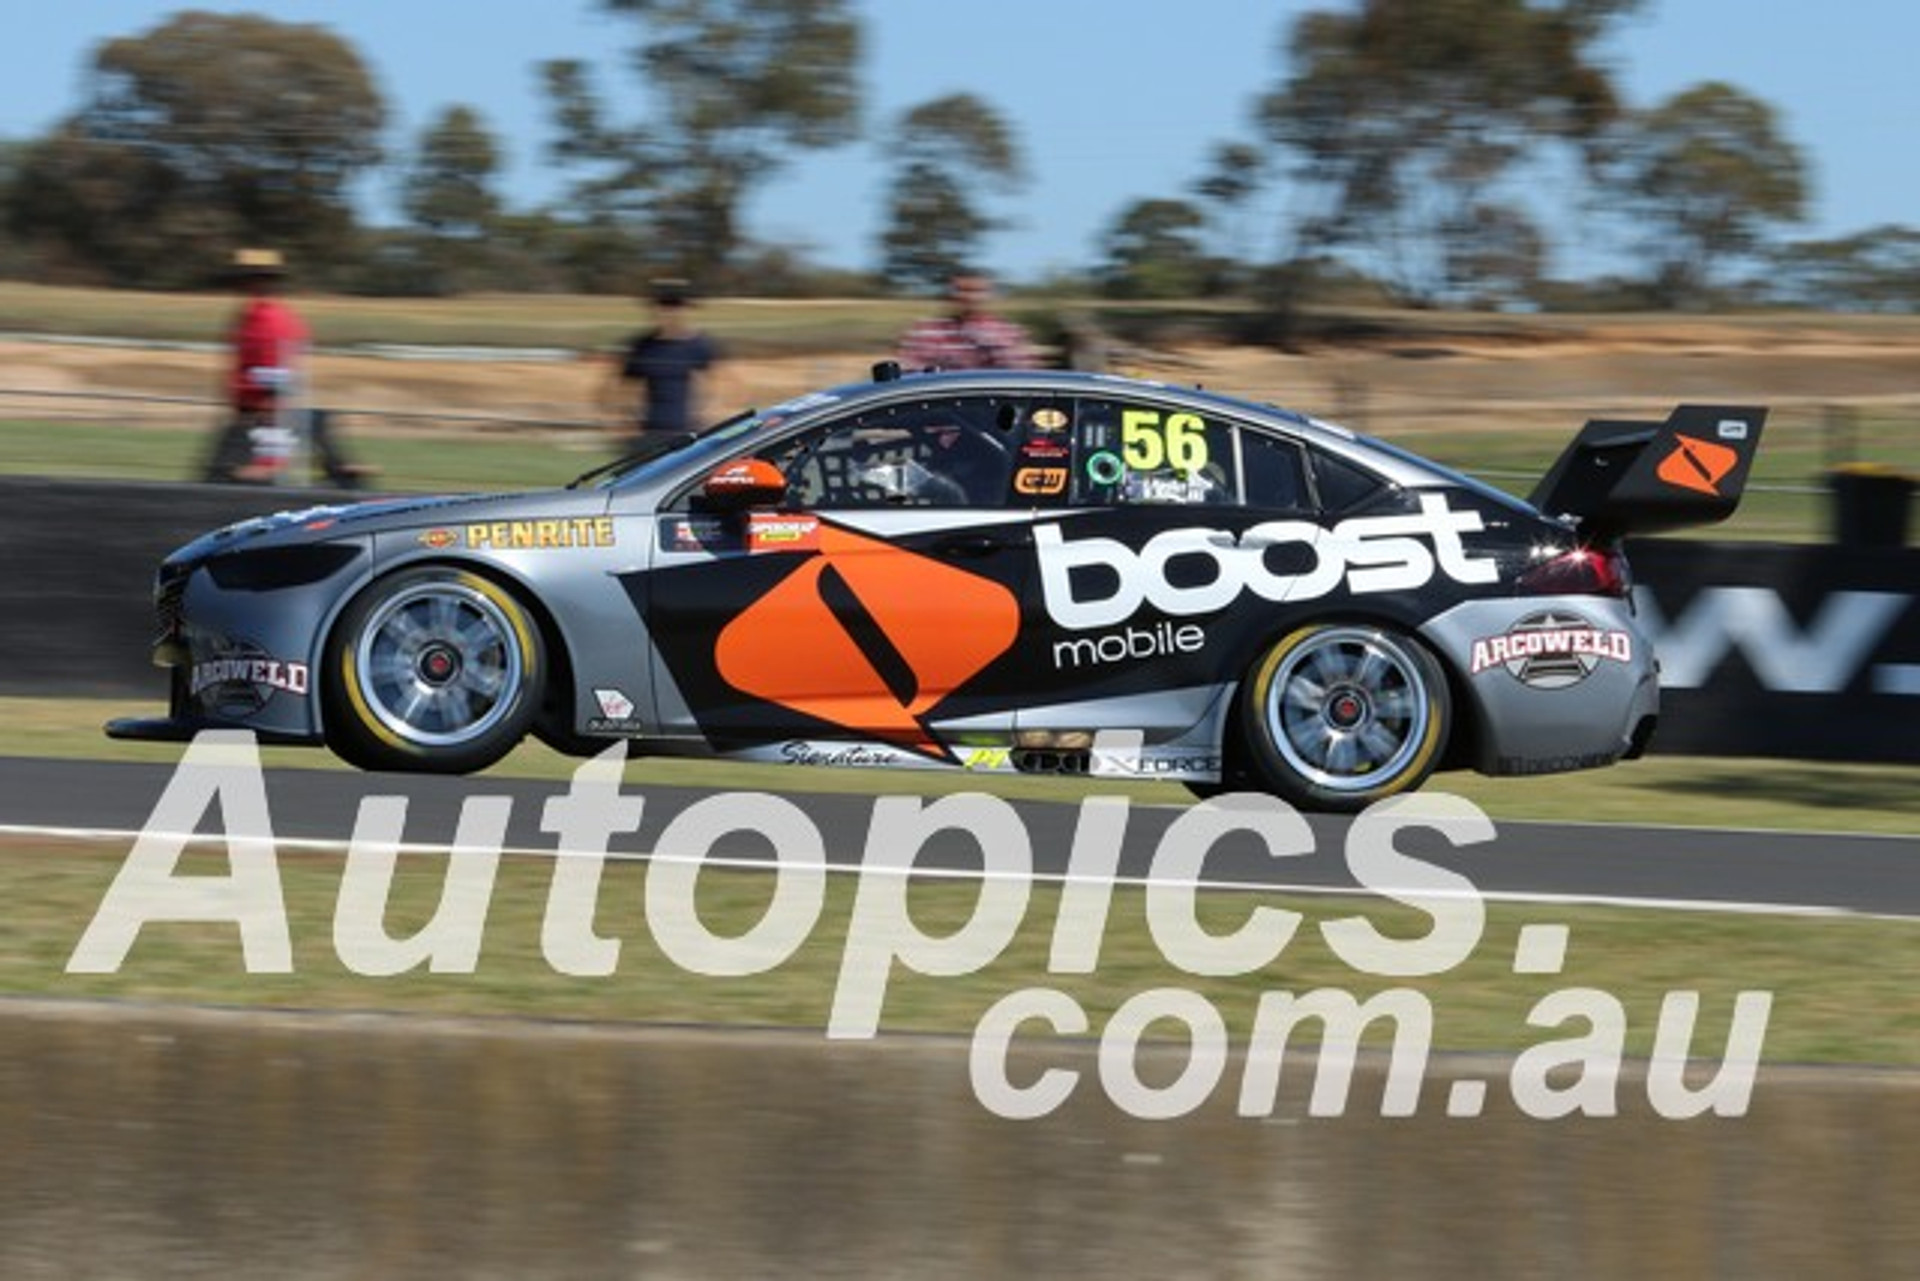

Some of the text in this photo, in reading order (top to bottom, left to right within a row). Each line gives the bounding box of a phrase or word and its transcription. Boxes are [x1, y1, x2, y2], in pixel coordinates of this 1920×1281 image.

[1121, 410, 1207, 470] 56
[467, 516, 615, 548] PENRITE
[1032, 492, 1500, 630] boost
[1053, 621, 1206, 668] mobile
[1469, 629, 1632, 675] ARCOWELD
